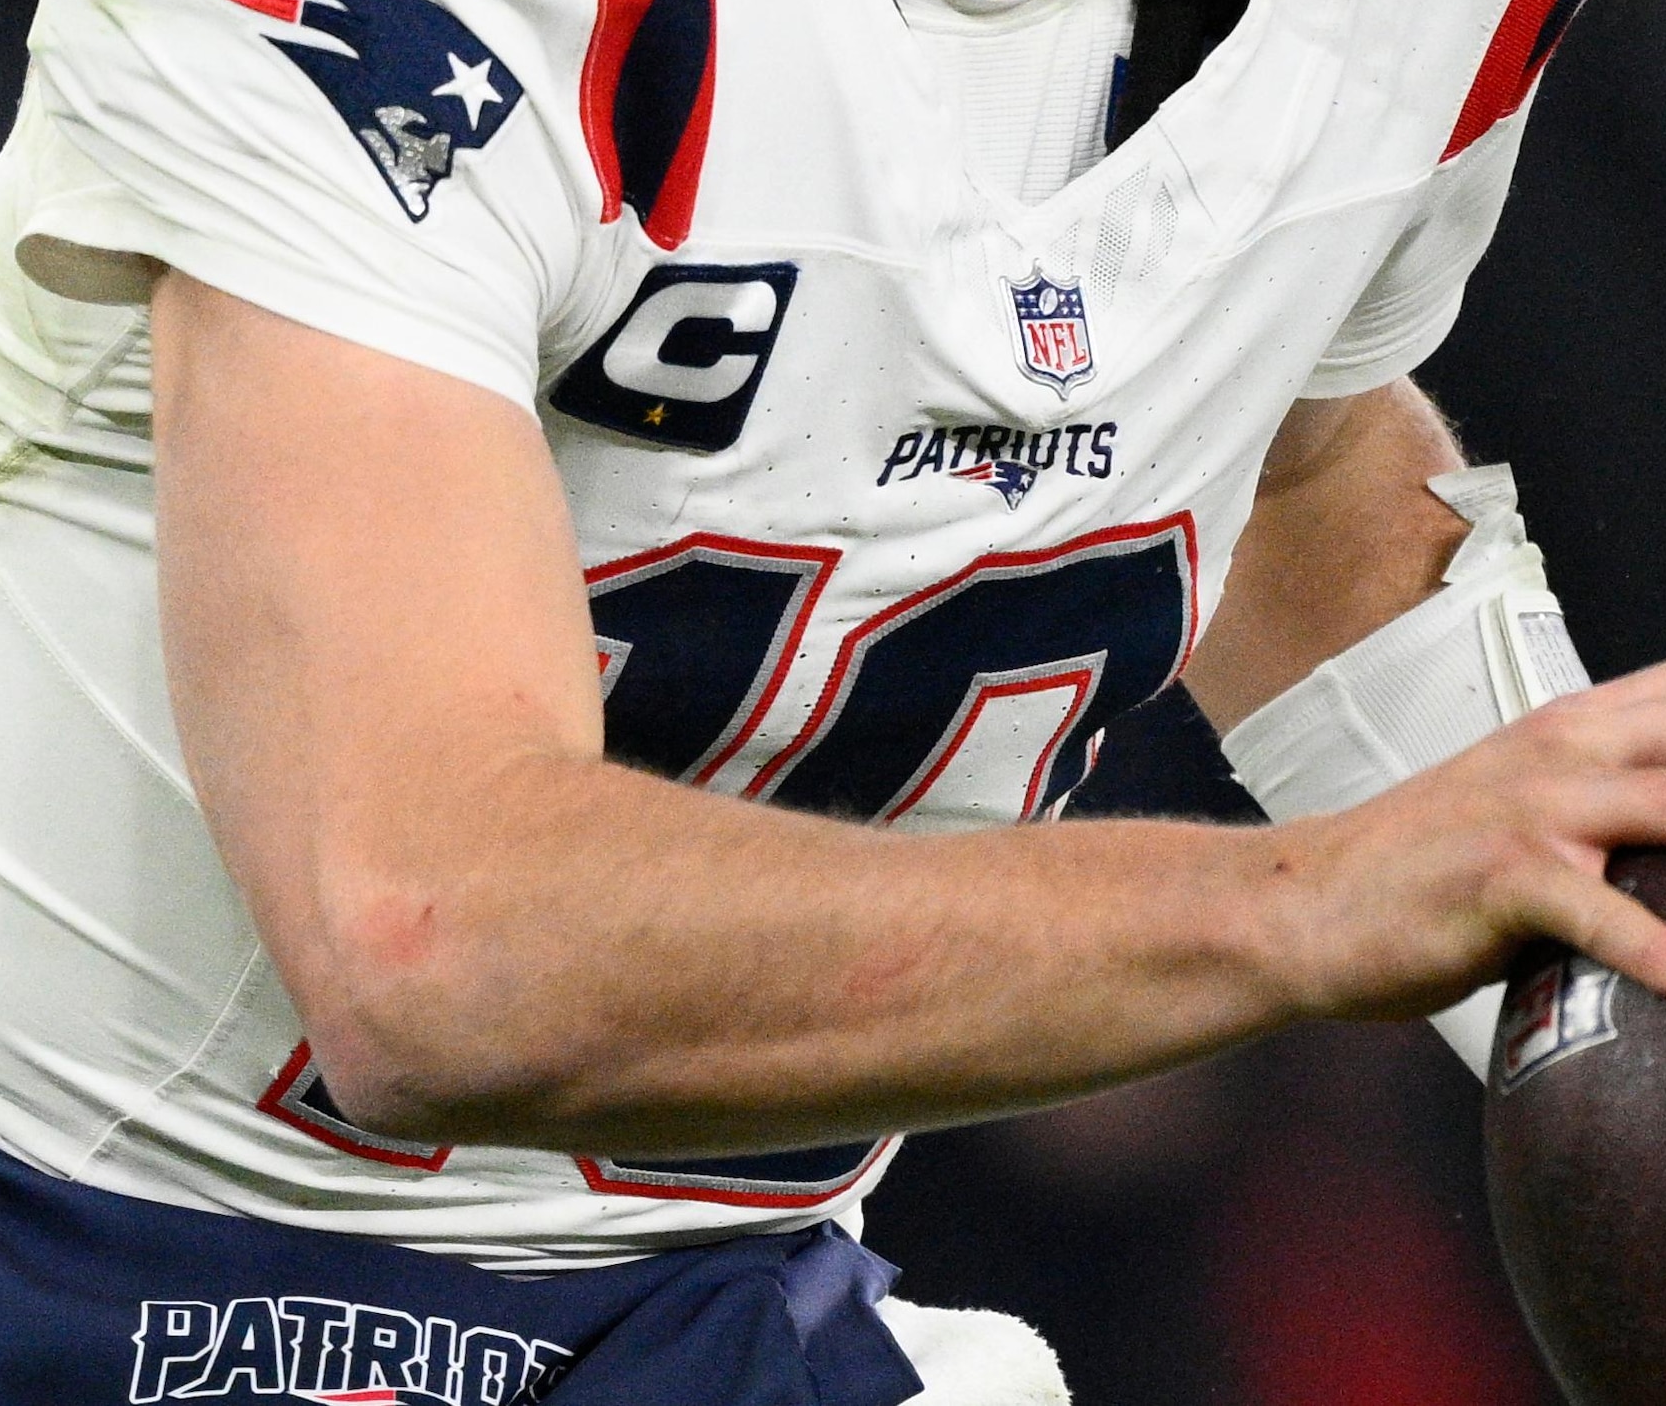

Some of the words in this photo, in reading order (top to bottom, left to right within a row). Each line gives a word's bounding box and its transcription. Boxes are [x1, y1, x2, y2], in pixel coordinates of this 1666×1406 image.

[602, 280, 777, 403] C
[1026, 322, 1087, 371] NFL
[877, 422, 1118, 487] PATRIOTS
[130, 1297, 575, 1405] PATRIOT
